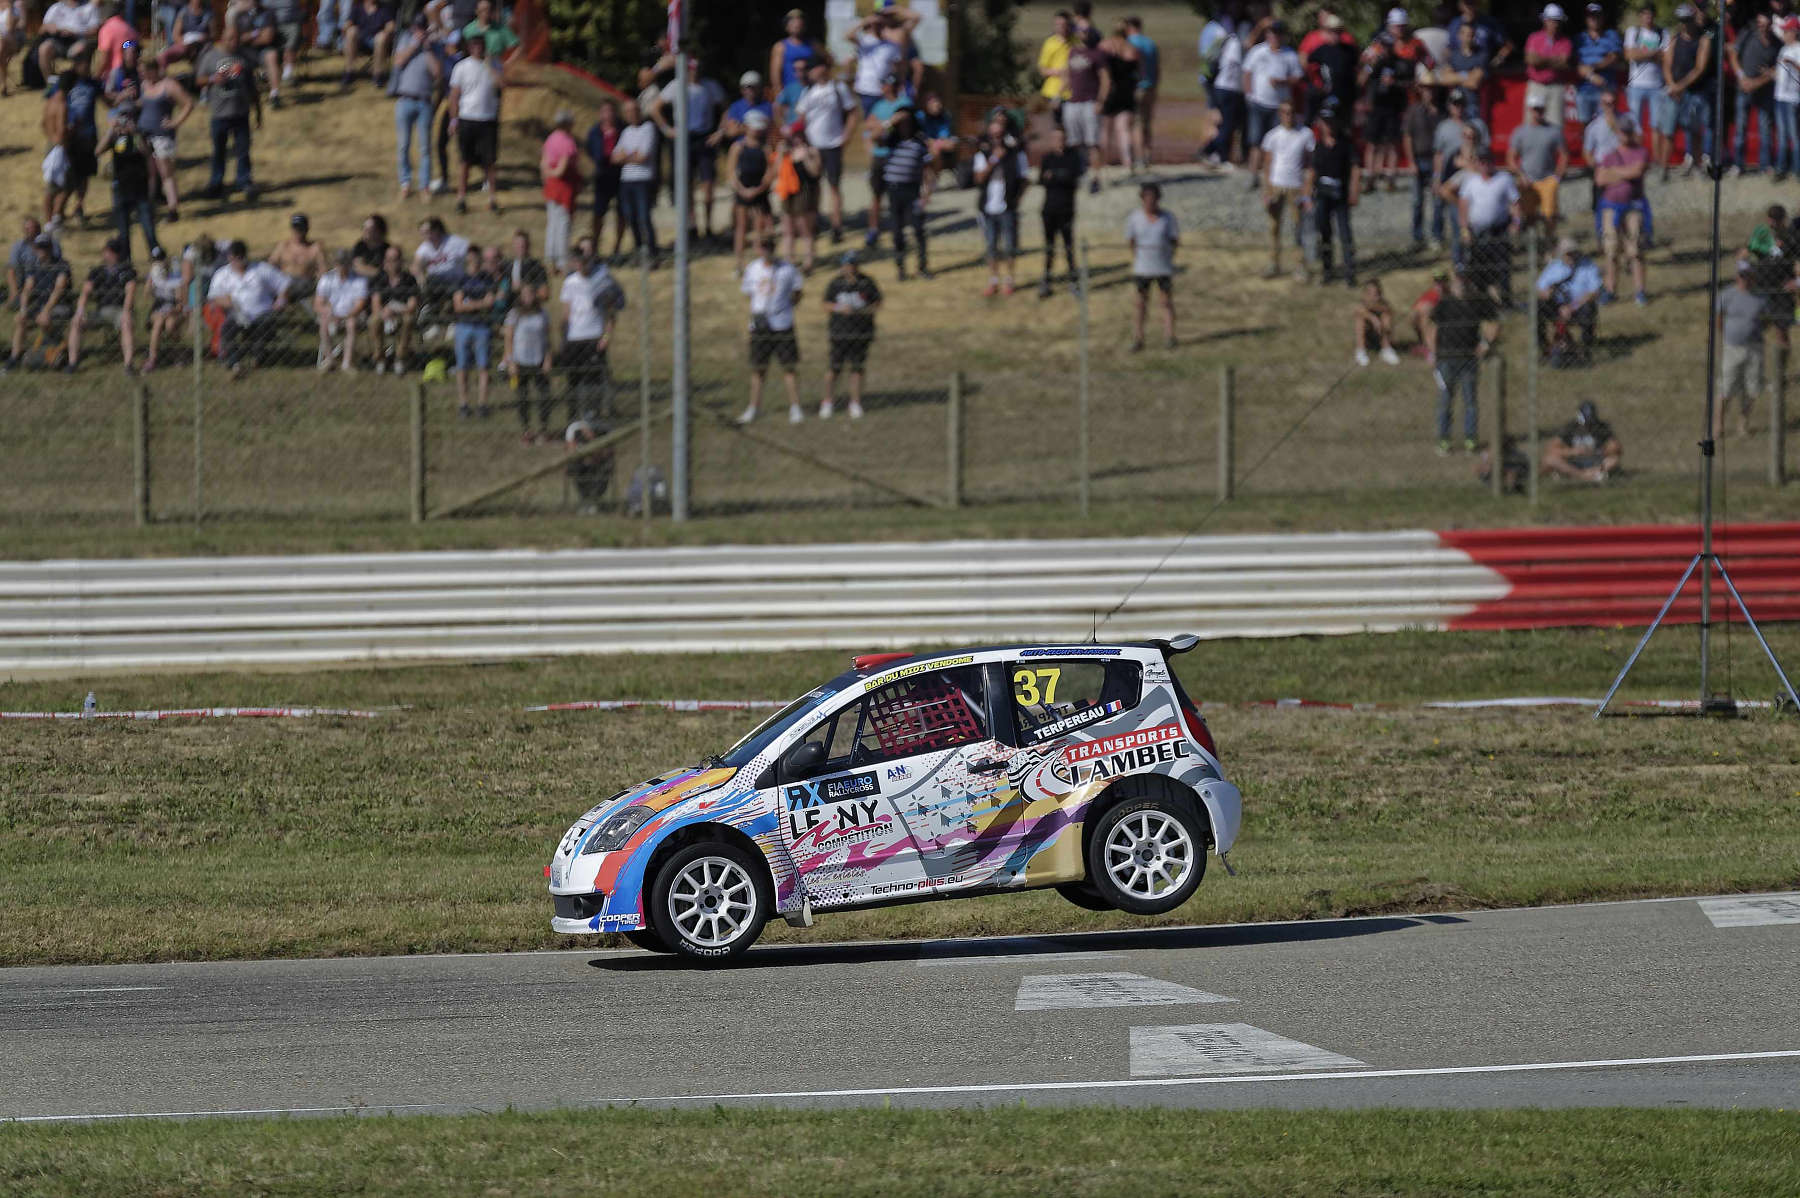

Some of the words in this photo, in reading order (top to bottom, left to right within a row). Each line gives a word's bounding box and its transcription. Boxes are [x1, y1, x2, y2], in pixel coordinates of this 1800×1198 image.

[864, 677, 885, 692] BAR
[885, 671, 899, 683] DU
[927, 656, 974, 670] VENDOME
[1013, 668, 1061, 707] 37
[1033, 706, 1105, 740] TERPEREAU
[1069, 726, 1179, 761] TRANSPORTS
[1070, 738, 1191, 788] LAMBEC
[828, 784, 874, 798] RALLYCROSS
[836, 799, 878, 830] NY
[1112, 801, 1160, 824] COOPER
[817, 822, 894, 852] COMPETITION
[870, 875, 965, 895] Techno-plus.eu
[600, 913, 641, 922] COOPER
